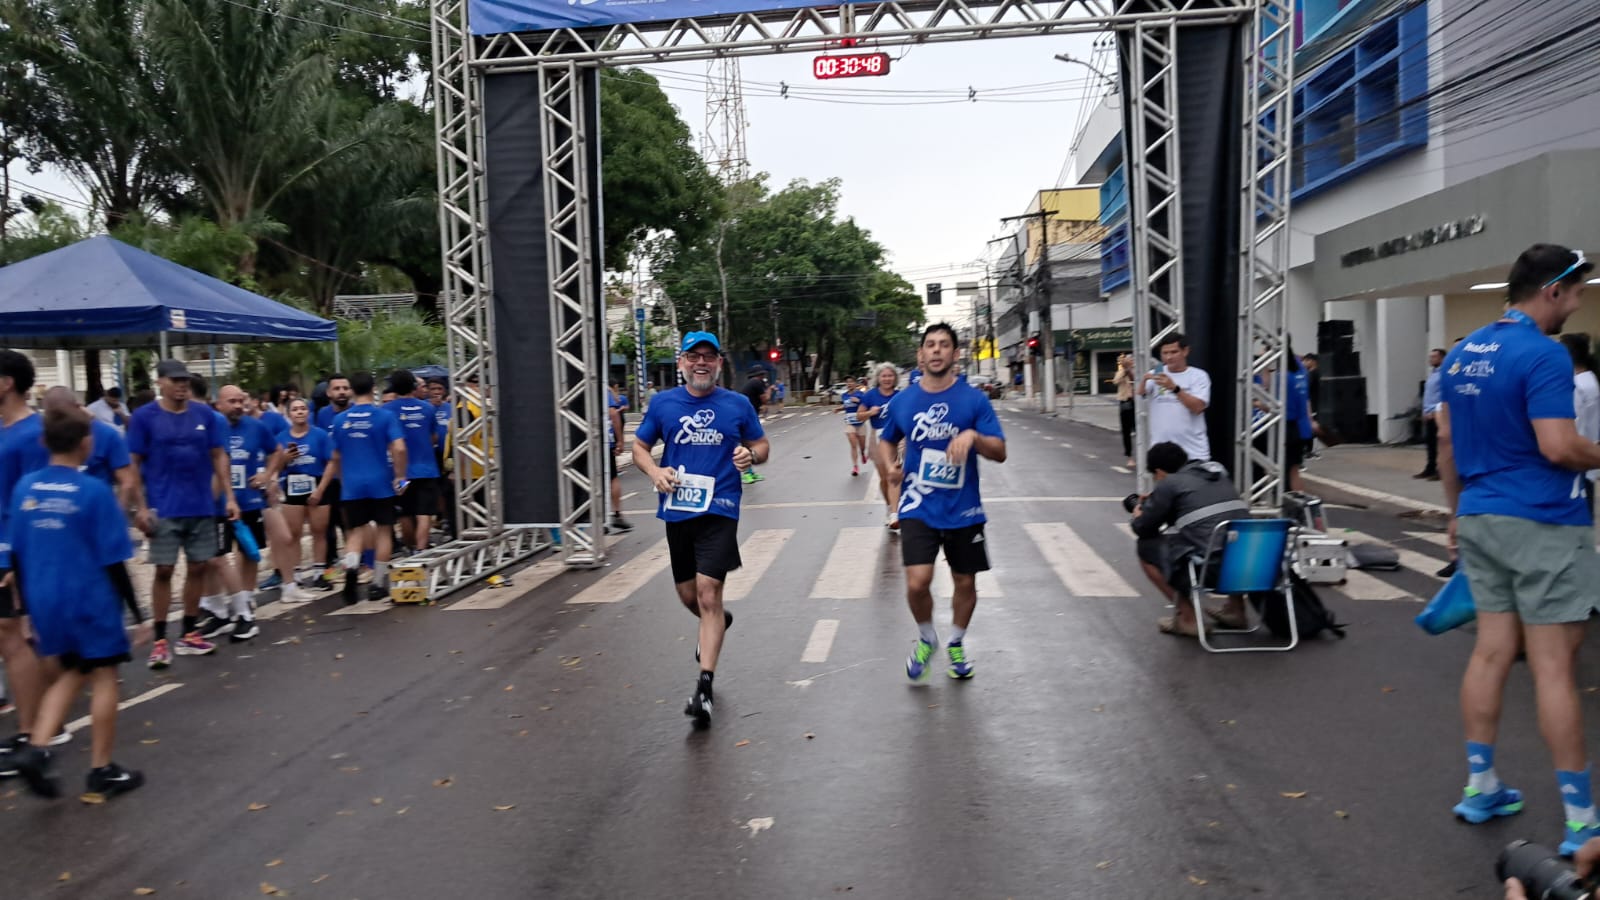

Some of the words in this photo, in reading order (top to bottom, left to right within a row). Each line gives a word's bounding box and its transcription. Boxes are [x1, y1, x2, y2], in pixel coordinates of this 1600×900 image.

[816, 56, 882, 76] 00:30:48
[928, 464, 957, 480] 242
[676, 487, 702, 503] 002
